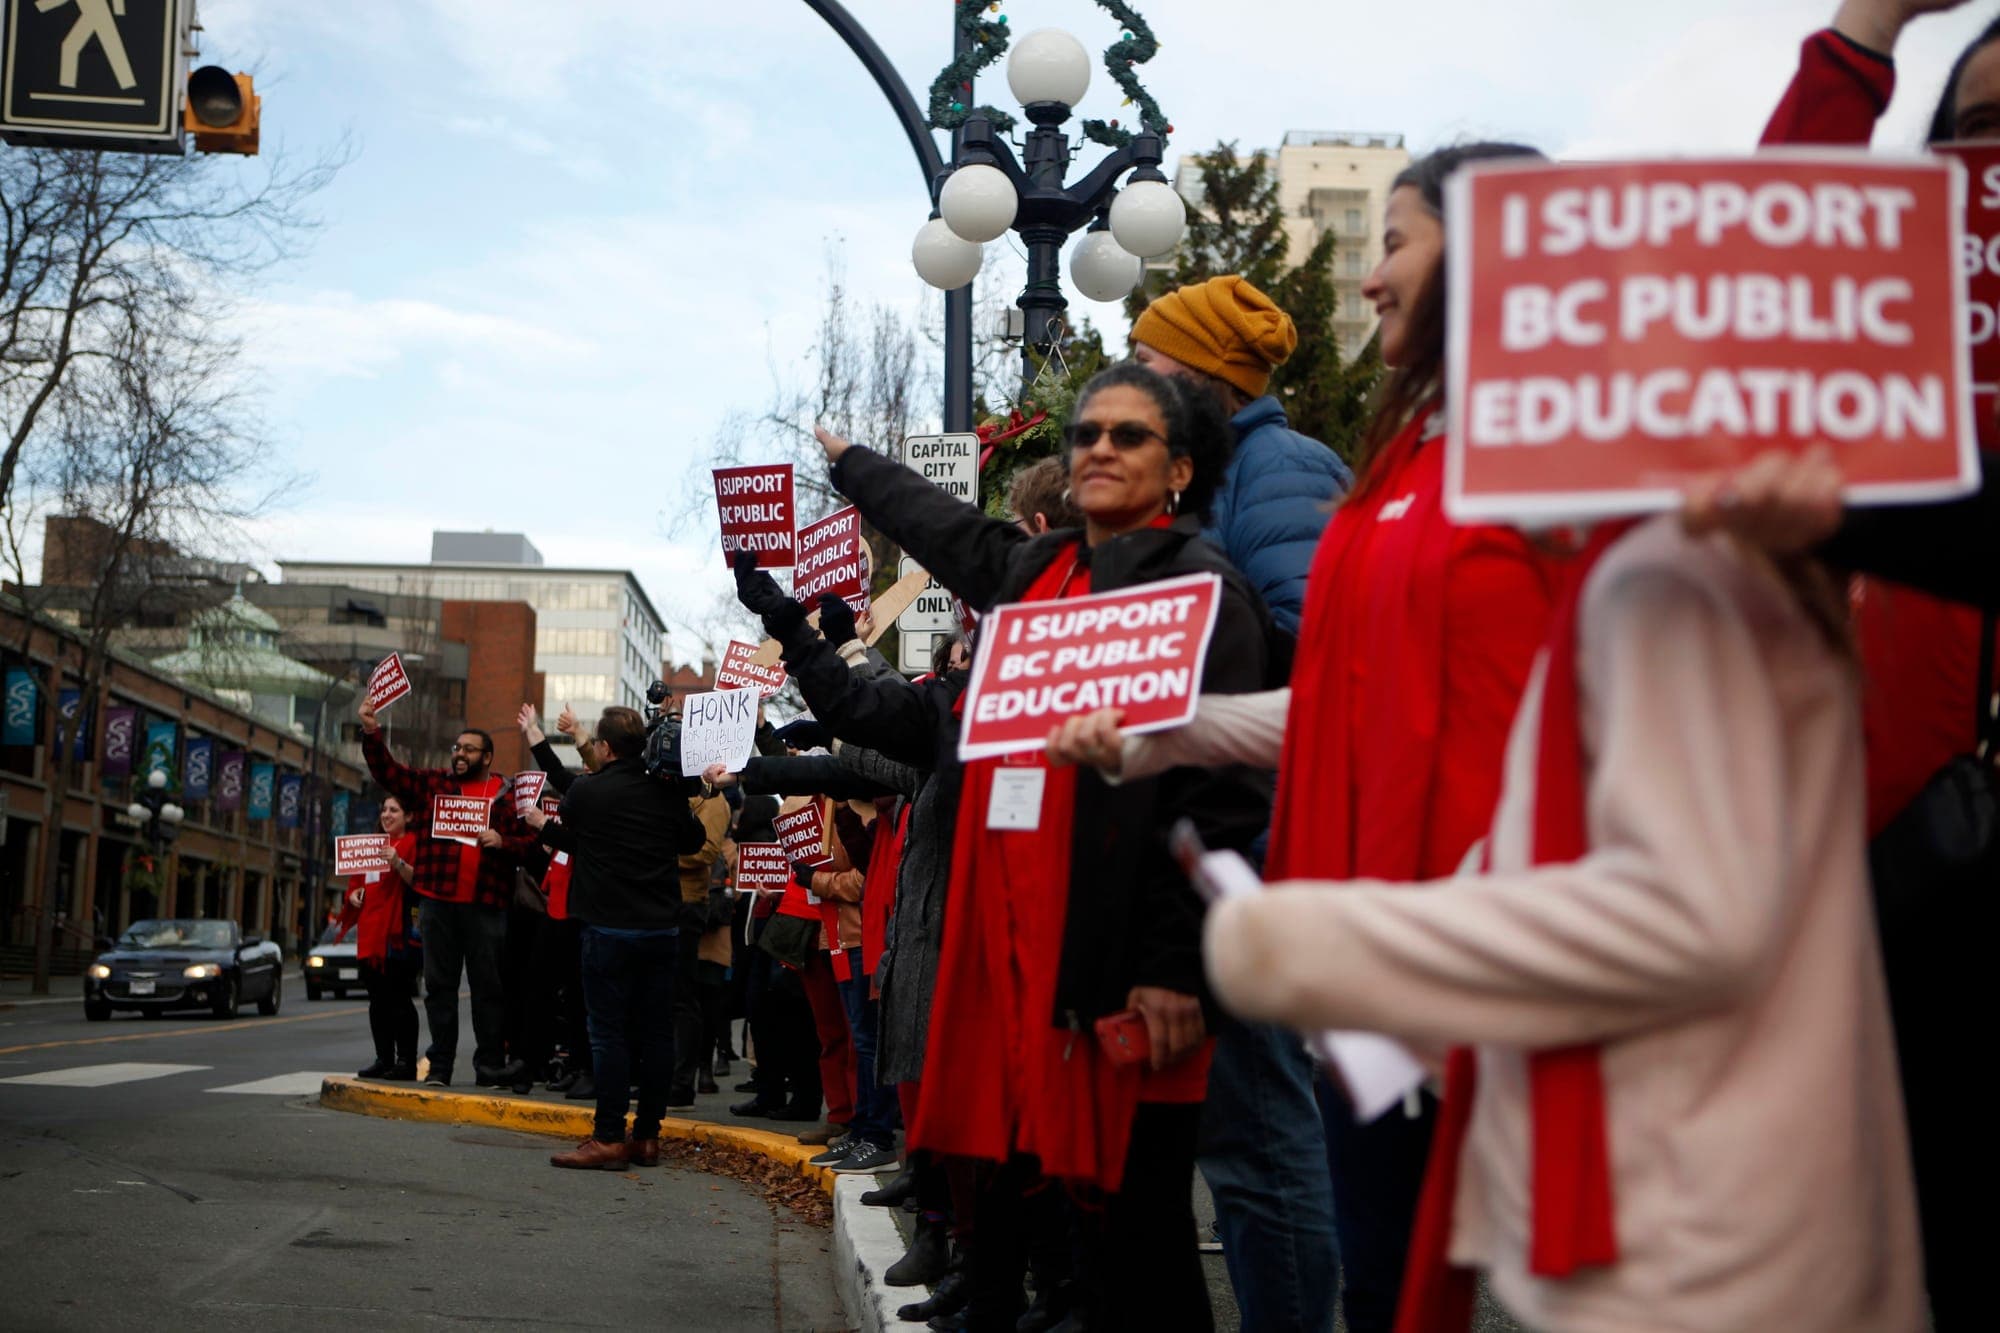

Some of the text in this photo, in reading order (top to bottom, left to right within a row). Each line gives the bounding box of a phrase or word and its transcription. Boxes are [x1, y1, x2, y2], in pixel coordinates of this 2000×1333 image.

[1503, 194, 1527, 258] I
[1542, 182, 1915, 255] SUPPORT
[1502, 280, 1606, 352] BC
[1619, 272, 1913, 347] PUBLIC
[1470, 367, 1946, 447] EDUCATION
[911, 442, 970, 458] CAPITAL
[923, 462, 956, 477] CITY
[718, 473, 785, 496] I SUPPORT
[721, 502, 784, 524] BC PUBLIC
[722, 531, 792, 552] EDUCATION
[798, 514, 855, 554] I SUPPORT
[797, 558, 811, 578] BC
[812, 539, 852, 571] PUBLIC
[795, 562, 857, 602] EDUCATION
[917, 597, 952, 613] ONLY
[1008, 595, 1198, 644] I SUPPORT
[731, 645, 736, 654] I
[999, 632, 1186, 681] BC PUBLIC
[727, 658, 742, 670] BC
[742, 663, 782, 682] PUBLIC
[371, 677, 407, 704] DUCATION
[975, 667, 1190, 723] EDUCATION
[689, 691, 750, 728] HONK
[705, 727, 746, 750] PUBLIC
[444, 799, 485, 810] SUPPORT
[440, 810, 485, 822] BC PUBLIC
[780, 810, 814, 832] SUPPORT
[435, 822, 486, 833] EDUCATION
[788, 826, 819, 845] PUBLIC
[342, 847, 382, 859] BC PUBLI
[344, 838, 385, 848] SUPPORT
[744, 847, 786, 856] I SUPPORT
[743, 861, 786, 870] BC PUBLIC
[740, 874, 788, 883] EDUCATION
